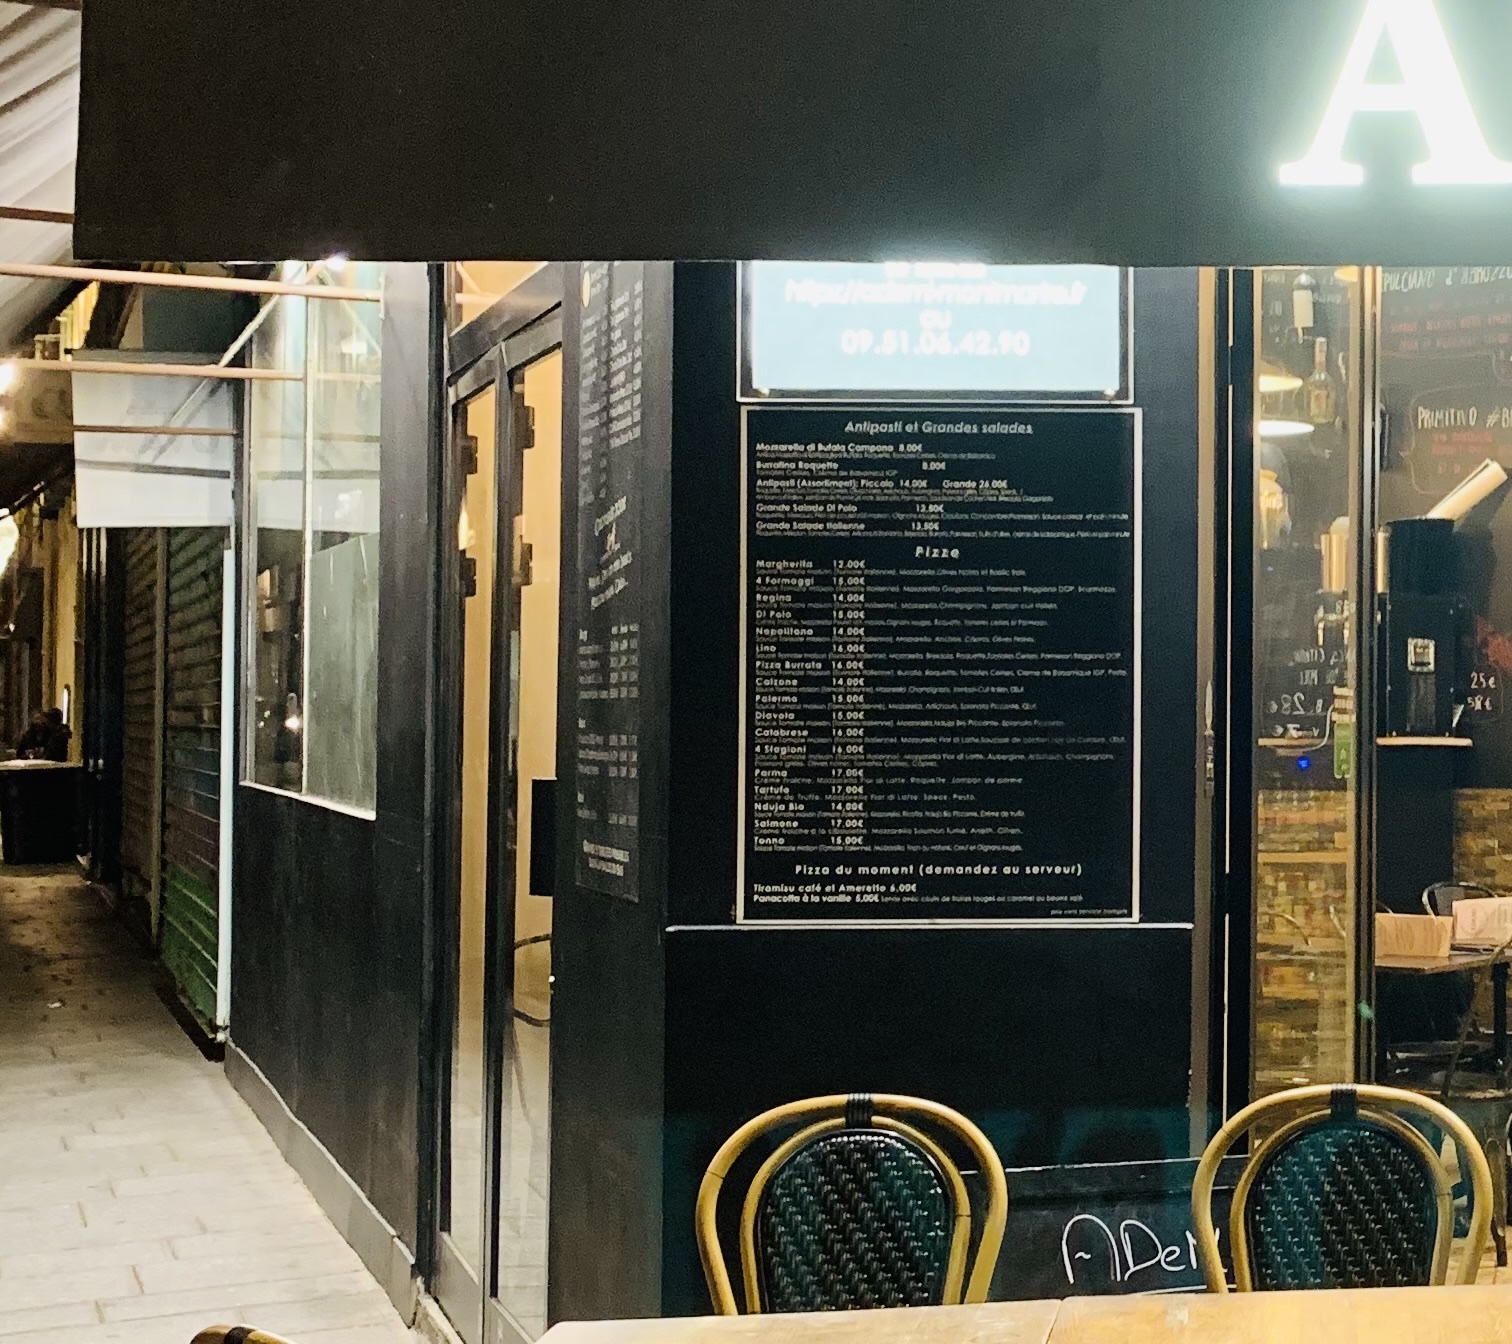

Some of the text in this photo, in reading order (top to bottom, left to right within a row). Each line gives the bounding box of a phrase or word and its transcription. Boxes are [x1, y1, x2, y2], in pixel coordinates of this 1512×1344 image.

[840, 329, 1031, 356] 09.51.06.42.90
[1418, 406, 1478, 430] PRIMITIVO
[845, 421, 1033, 435] Antipasti et Grandes salades
[806, 443, 815, 452] di
[798, 461, 838, 472] Roquette
[943, 480, 977, 488] Grande
[756, 504, 790, 512] Grande
[793, 504, 824, 512] Salade
[756, 522, 790, 530] Grande
[793, 522, 824, 530] Salade
[915, 547, 960, 558] Pizza
[756, 560, 813, 570] Margherita
[766, 577, 814, 586] Formaggi
[756, 594, 792, 603] Regina
[756, 662, 822, 670] Pizza Burrata
[755, 678, 798, 686] Calzone
[755, 695, 797, 703] Palermo
[755, 712, 795, 720] Diavola
[755, 729, 808, 737] Calabrese
[765, 746, 806, 755] Stagioni
[754, 769, 787, 777] Parma
[754, 786, 789, 794] Tartufo
[754, 803, 804, 812] Nduja Bio
[754, 820, 798, 828] Salmone
[795, 864, 1082, 876] Pizza du moment (demandez au serveur)
[753, 883, 835, 892] Tiramisu café et
[753, 894, 800, 903] Panacotta
[811, 894, 819, 902] la
[822, 894, 851, 903] vanille
